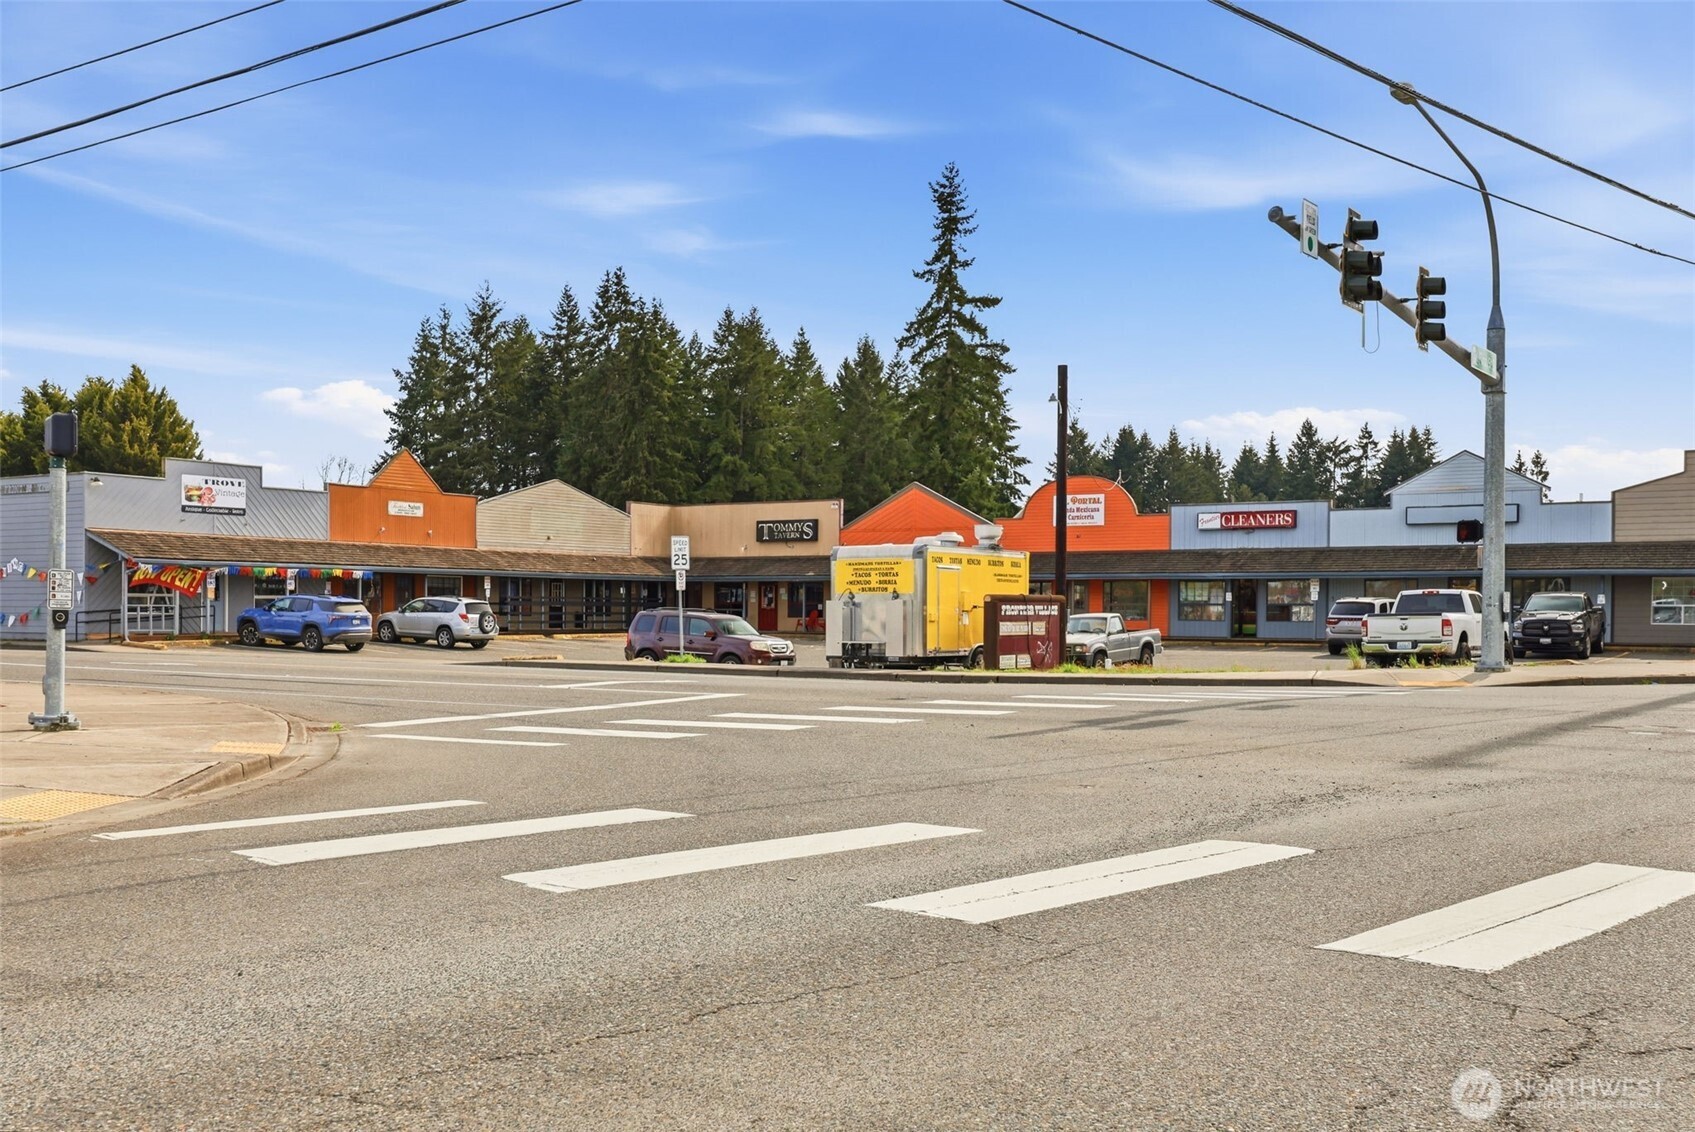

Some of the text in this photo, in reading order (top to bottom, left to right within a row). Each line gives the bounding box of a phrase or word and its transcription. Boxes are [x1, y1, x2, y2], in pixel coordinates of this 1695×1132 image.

[202, 479, 245, 488] TROVE
[214, 489, 245, 498] Vintage
[1071, 496, 1102, 504] PORTAL
[1222, 513, 1292, 526] CLEANERS
[674, 554, 688, 566] 25
[160, 565, 201, 592] OPEN!
[1001, 604, 1058, 616] FRONTIER VILLAGE
